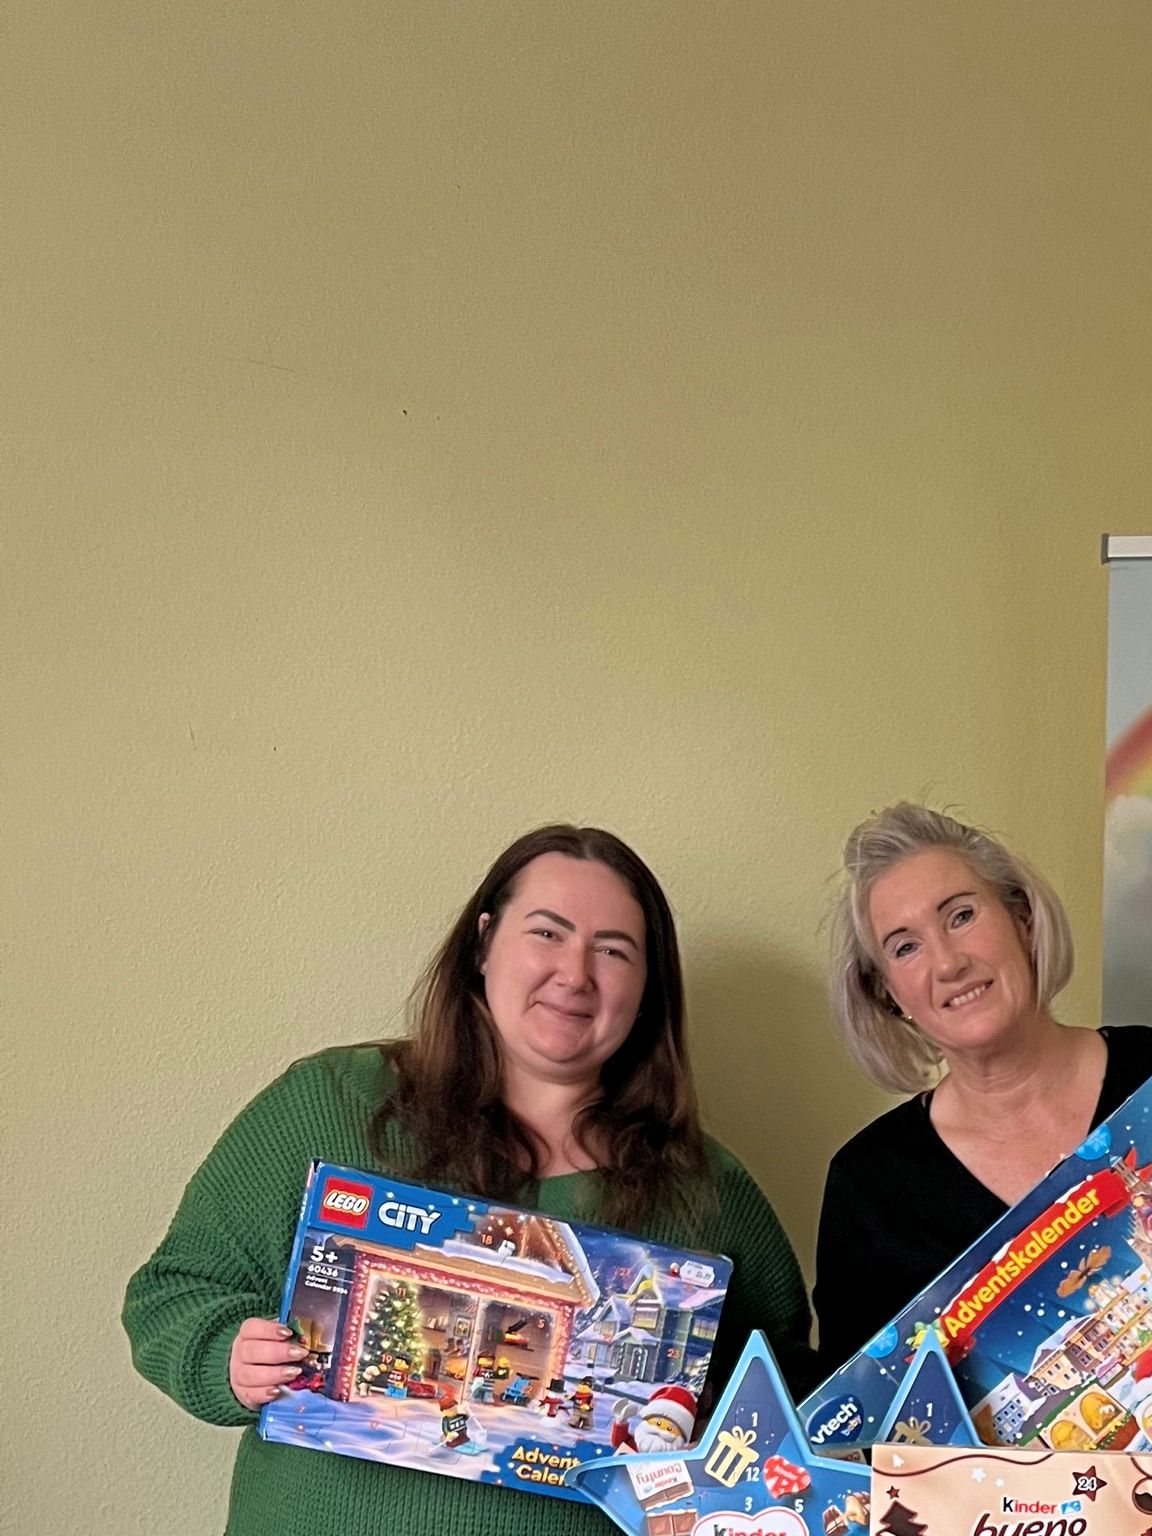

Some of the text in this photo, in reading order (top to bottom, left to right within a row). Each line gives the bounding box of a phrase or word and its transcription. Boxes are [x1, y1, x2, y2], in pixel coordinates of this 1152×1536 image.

[326, 1191, 442, 1235] LEGO CITY
[310, 1246, 338, 1263] 5+
[308, 1264, 339, 1278] 60436
[943, 1188, 1098, 1340] Adventskalender
[751, 1413, 758, 1428] 1
[810, 1400, 858, 1445] vtech
[512, 1446, 581, 1469] Advent
[745, 1466, 760, 1482] 12
[1079, 1477, 1098, 1490] 24
[744, 1497, 753, 1512] 3
[794, 1499, 804, 1514] 5
